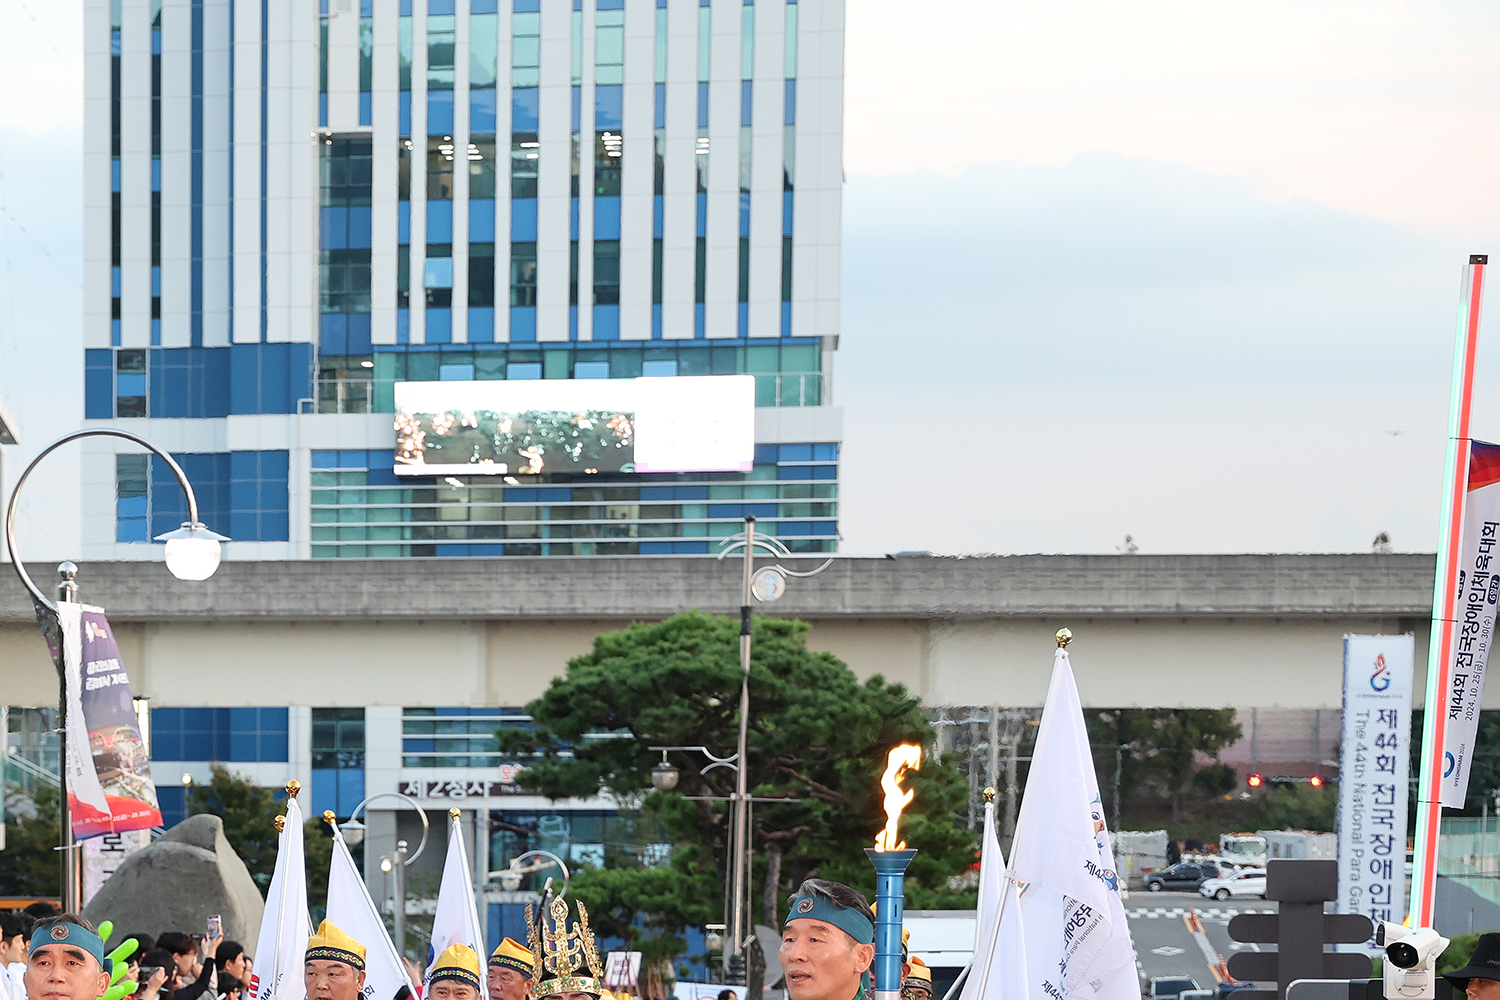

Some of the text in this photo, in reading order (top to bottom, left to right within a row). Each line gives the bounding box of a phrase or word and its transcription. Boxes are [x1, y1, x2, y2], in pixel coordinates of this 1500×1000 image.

[1449, 521, 1500, 721] 제44회 전국장애인체육대회
[1464, 703, 1475, 721] 2024.
[1472, 661, 1484, 687] 25(금)
[1481, 615, 1493, 637] 30(수)
[1356, 709, 1370, 740] The
[1374, 708, 1399, 776] 제44회
[1352, 741, 1368, 779] 44th
[1349, 782, 1368, 845] National
[1349, 848, 1365, 882] Para
